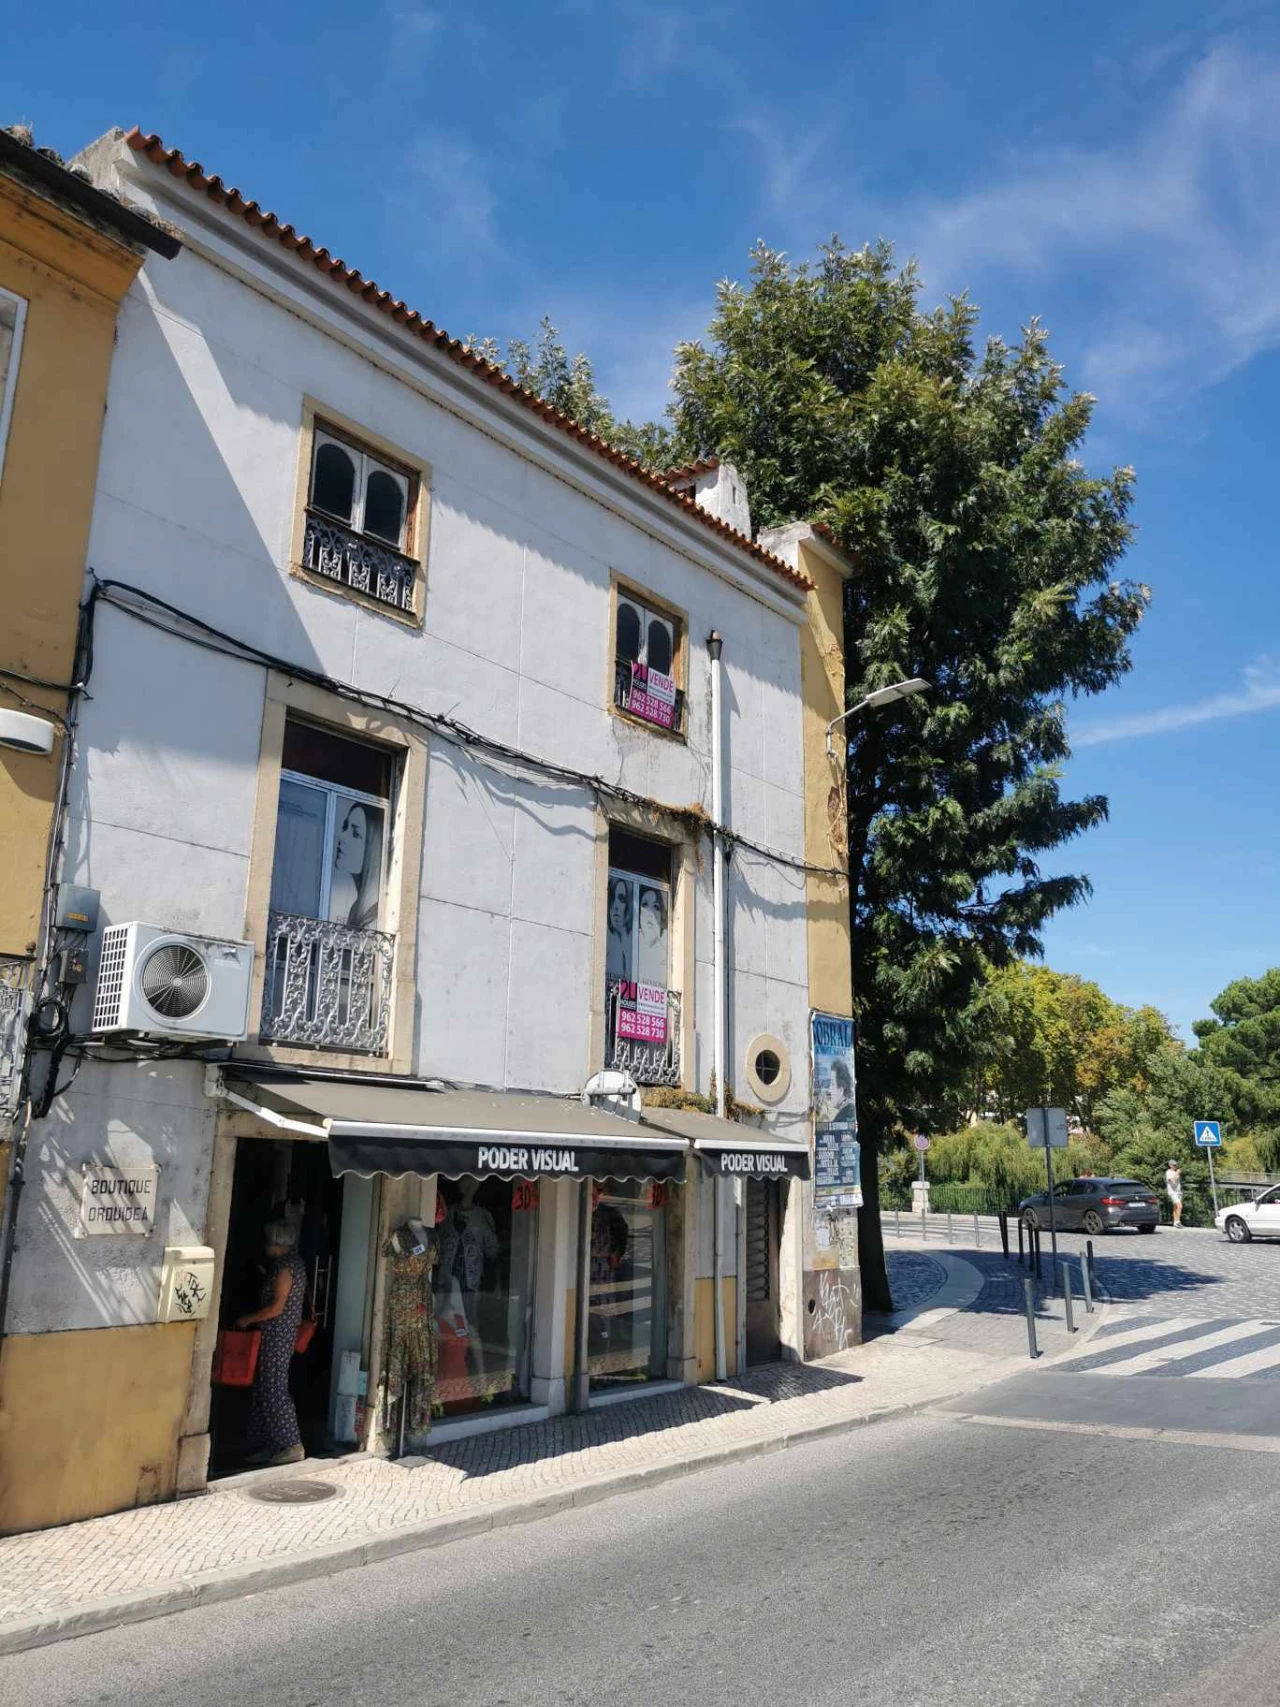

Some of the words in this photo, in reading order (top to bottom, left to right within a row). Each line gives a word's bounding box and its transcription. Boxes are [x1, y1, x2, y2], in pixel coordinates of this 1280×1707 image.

[650, 672, 673, 692] VENDE
[633, 690, 645, 702] 962
[646, 696, 659, 708] 528
[659, 703, 671, 714] 566
[631, 701, 645, 712] 962
[645, 706, 658, 719] 528
[658, 711, 671, 724] 730
[638, 987, 664, 1005] VENDE
[621, 1011, 636, 1023] 962
[637, 1015, 650, 1026] 528
[651, 1017, 665, 1028] 566
[621, 1022, 636, 1034] 962
[636, 1025, 650, 1036] 528
[651, 1028, 665, 1039] 730
[478, 1146, 528, 1170] PODER
[531, 1149, 579, 1172] VISUAL
[721, 1153, 754, 1171] PODER
[755, 1154, 788, 1172] VISUAL
[91, 1180, 152, 1196] BOUTIQUE
